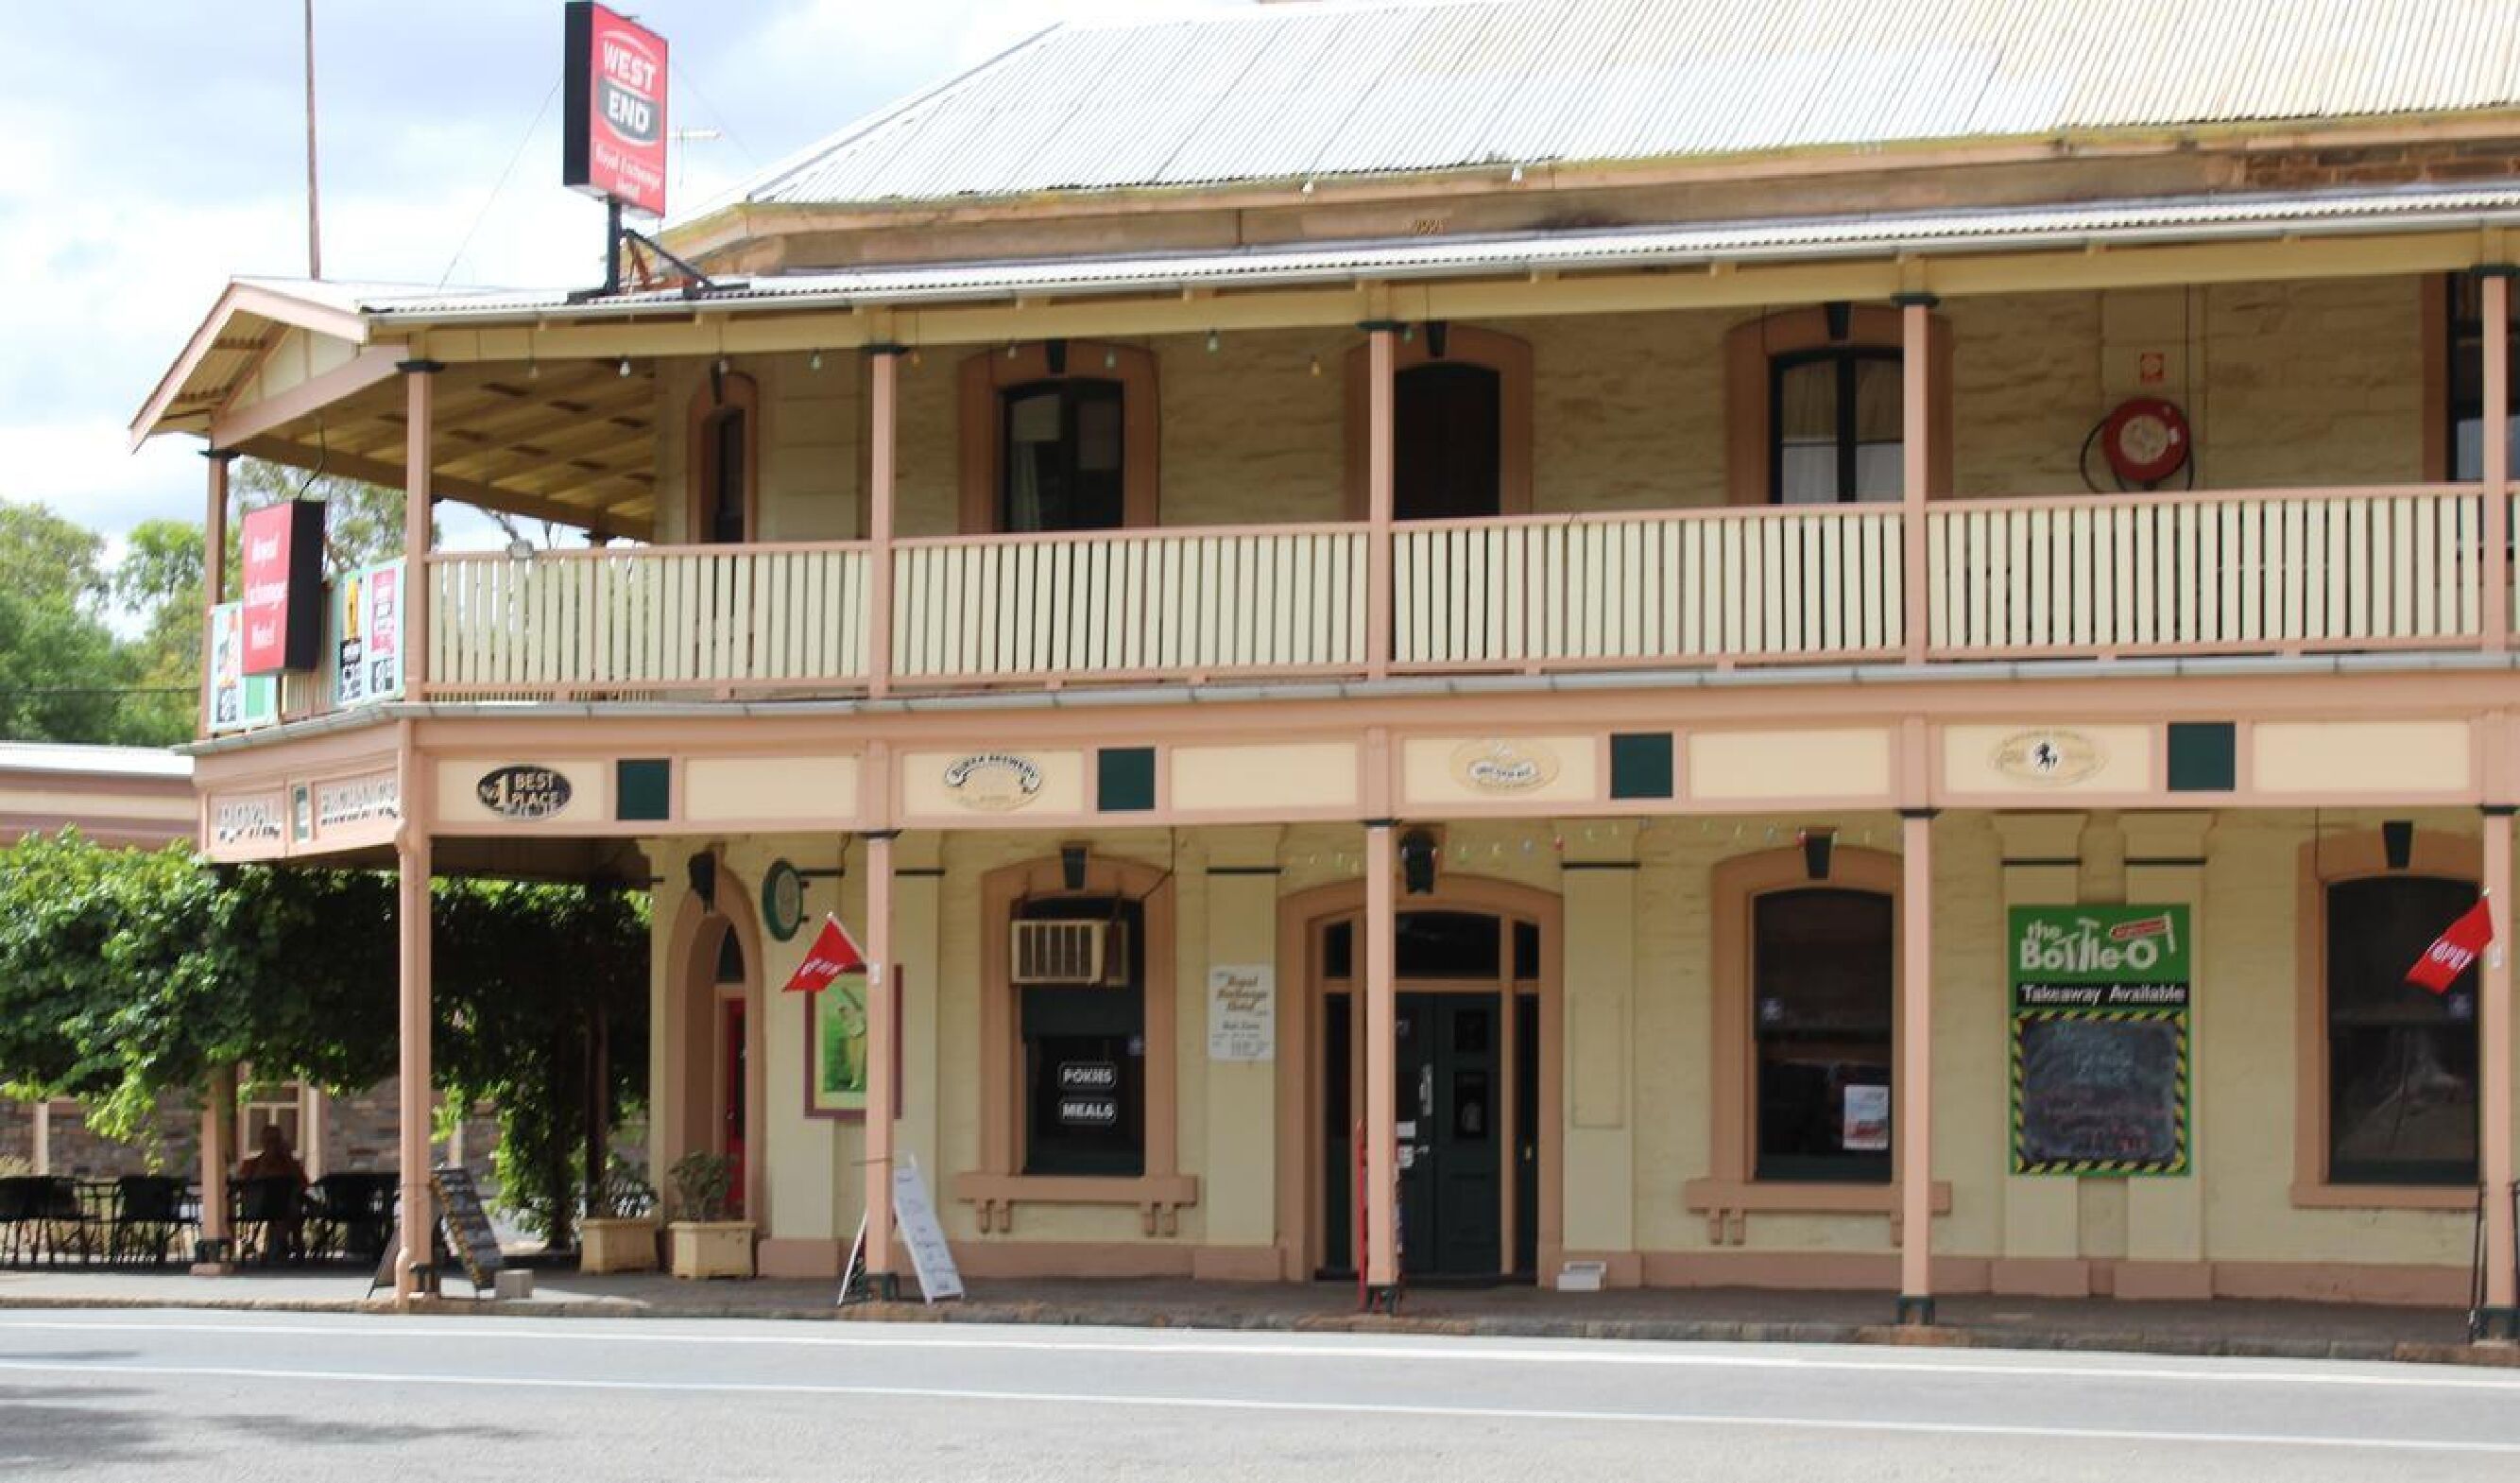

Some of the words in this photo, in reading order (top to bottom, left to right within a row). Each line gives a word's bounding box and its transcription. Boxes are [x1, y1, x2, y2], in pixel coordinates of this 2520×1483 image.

[603, 41, 657, 92] WEST
[607, 89, 652, 133] END
[515, 771, 555, 791] BEST
[511, 790, 560, 806] PLACE
[2027, 918, 2063, 940] the
[2021, 984, 2102, 1007] Takeaway
[2108, 984, 2186, 1003] Available
[1063, 1067, 1113, 1083] POKIES
[1062, 1102, 1113, 1119] MEALS
